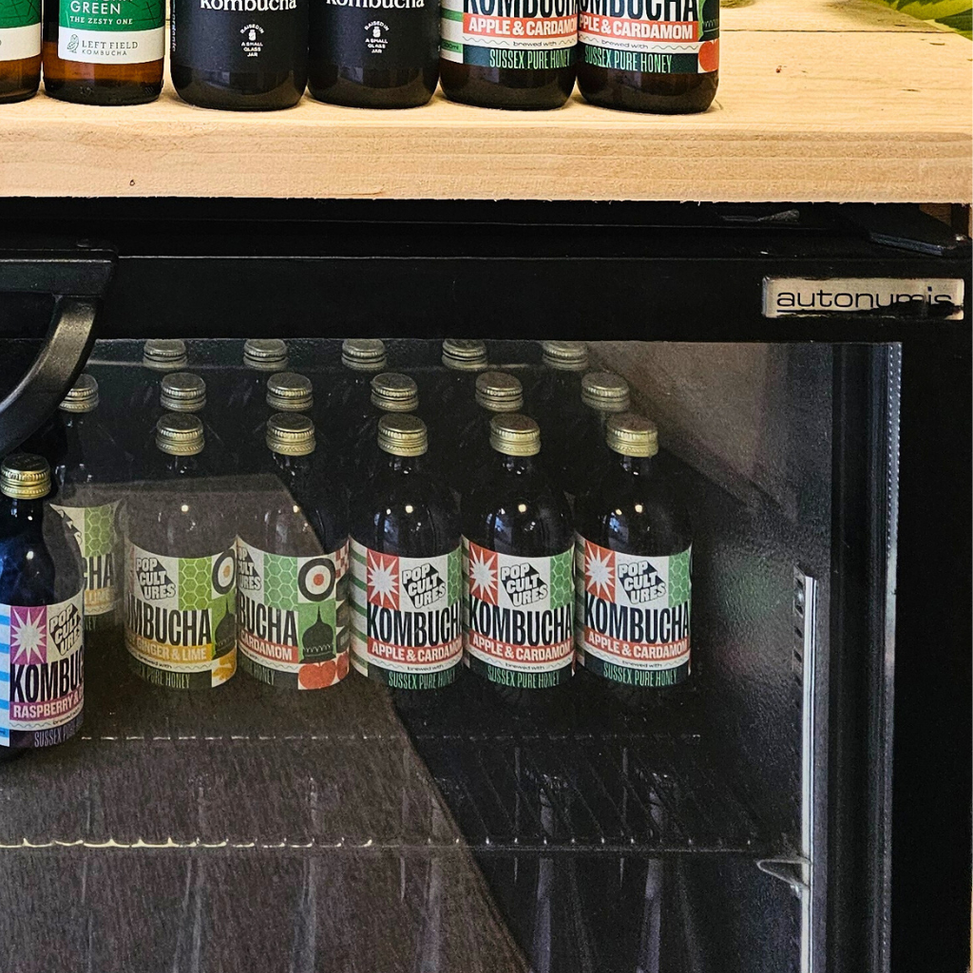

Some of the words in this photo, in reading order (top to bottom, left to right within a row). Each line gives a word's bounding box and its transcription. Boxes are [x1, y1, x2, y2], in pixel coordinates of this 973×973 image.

[70, 0, 121, 15] GREEN
[70, 16, 85, 24] THE
[88, 17, 112, 25] ZESTY
[469, 17, 511, 34] APPLE
[513, 20, 524, 36] &
[578, 17, 600, 34] PPLE
[601, 20, 611, 36] &
[613, 21, 693, 39] CARDAMOM
[82, 40, 106, 49] LEFT
[109, 41, 138, 49] FIELD
[489, 49, 525, 69] SUSSEX
[527, 49, 549, 69] PURE
[584, 46, 612, 67] SUSSEX
[615, 50, 638, 71] PURE
[640, 53, 672, 74] HONEY
[136, 558, 157, 572] POP
[402, 563, 430, 584] POP
[500, 563, 530, 579] POP
[618, 560, 647, 579] POP
[139, 572, 166, 585] CULT
[408, 573, 439, 596] CULT
[506, 574, 539, 594] CULT
[624, 571, 658, 592] CULT
[143, 583, 176, 600] URES
[414, 584, 446, 608] URES
[513, 584, 548, 607] URES
[630, 582, 666, 604] URES
[49, 603, 73, 624] POP
[469, 593, 572, 646] KOMBUCHA
[585, 592, 688, 643] KOMBUCHA
[137, 638, 170, 659] GINGER
[183, 648, 207, 660] LIME
[241, 631, 292, 660] CARDAMOM
[372, 641, 405, 660] APPLE
[473, 636, 503, 657] APPLE
[516, 641, 571, 661] CARDAMOM
[589, 632, 619, 654] APPLE
[633, 638, 687, 659] CARDAMOM
[388, 671, 417, 689] SUSSEX
[419, 674, 436, 689] PURE
[487, 666, 515, 687] SUSSEX
[517, 671, 537, 688] PURE
[538, 671, 560, 687] HONEY
[603, 663, 632, 685] SUSSEX
[634, 669, 654, 687] PURE
[656, 669, 677, 687] HONEY
[14, 694, 73, 718] RASPBERRY
[34, 728, 62, 747] SUSSEX
